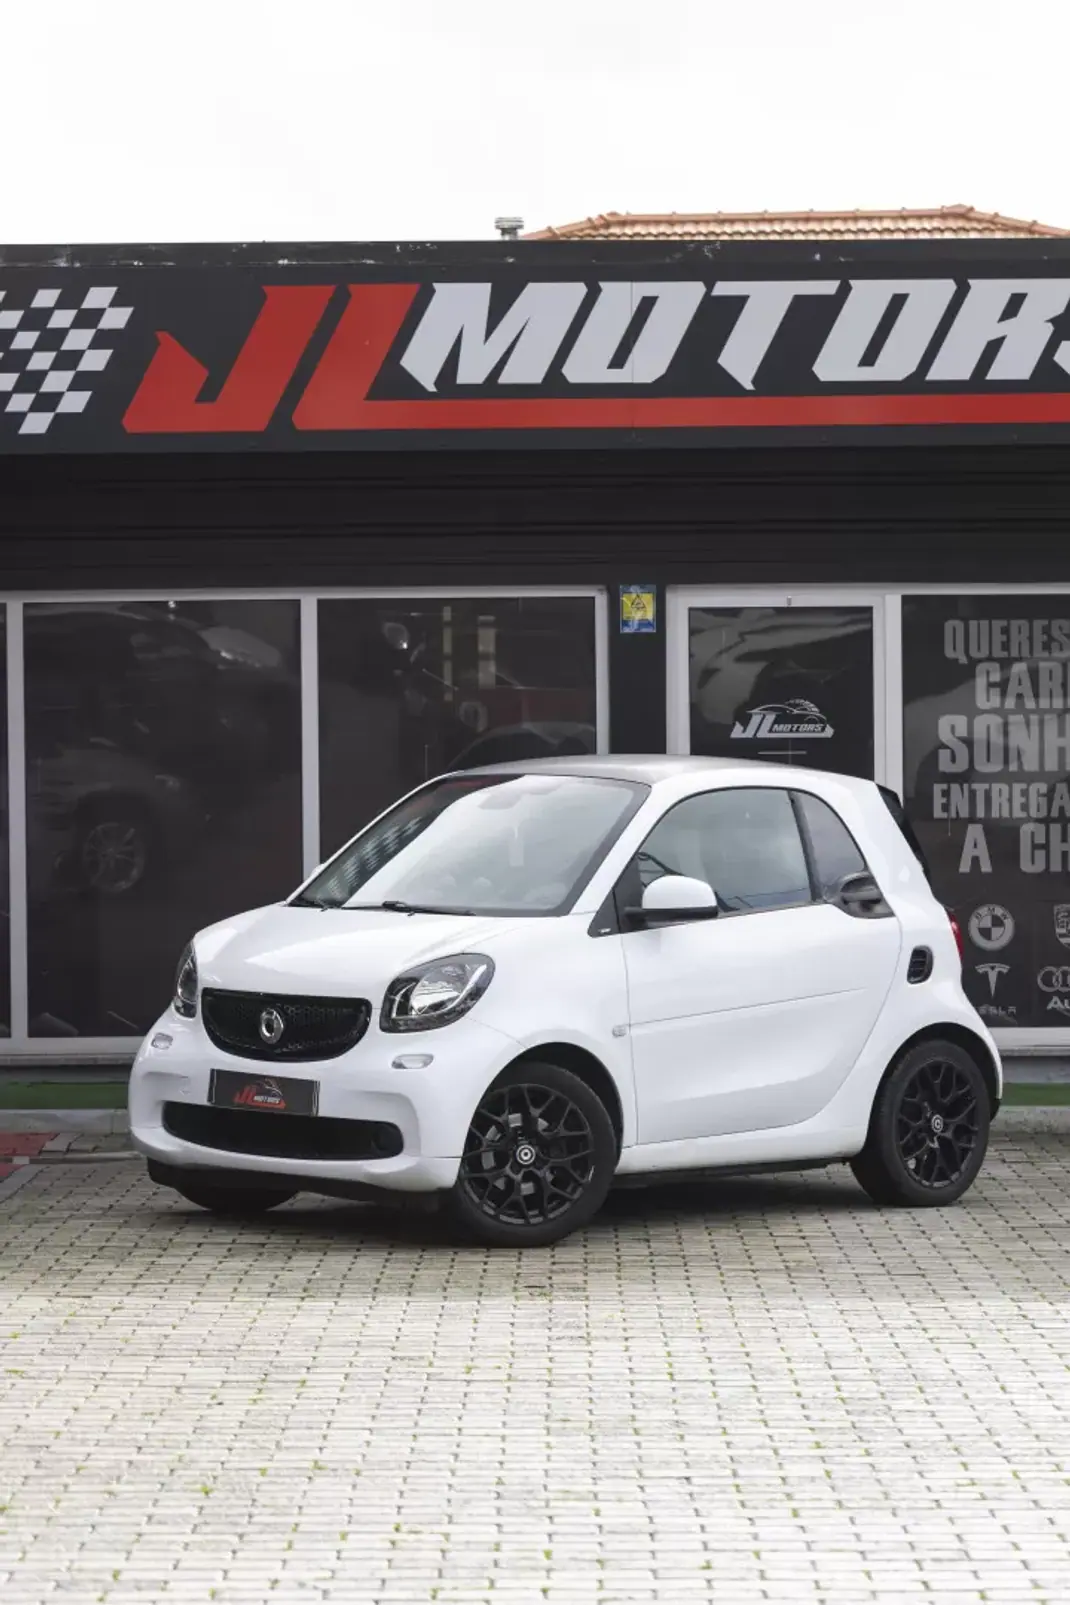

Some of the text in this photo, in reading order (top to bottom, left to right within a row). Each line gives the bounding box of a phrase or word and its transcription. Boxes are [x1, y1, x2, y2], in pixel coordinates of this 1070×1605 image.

[399, 278, 1070, 391] MOTOR
[944, 619, 1070, 664] QUERES
[975, 661, 1070, 710] CAR
[772, 723, 824, 733] MOTORS
[938, 714, 1070, 773] SONH
[933, 783, 1070, 819] ENTREGA
[958, 823, 993, 873] A
